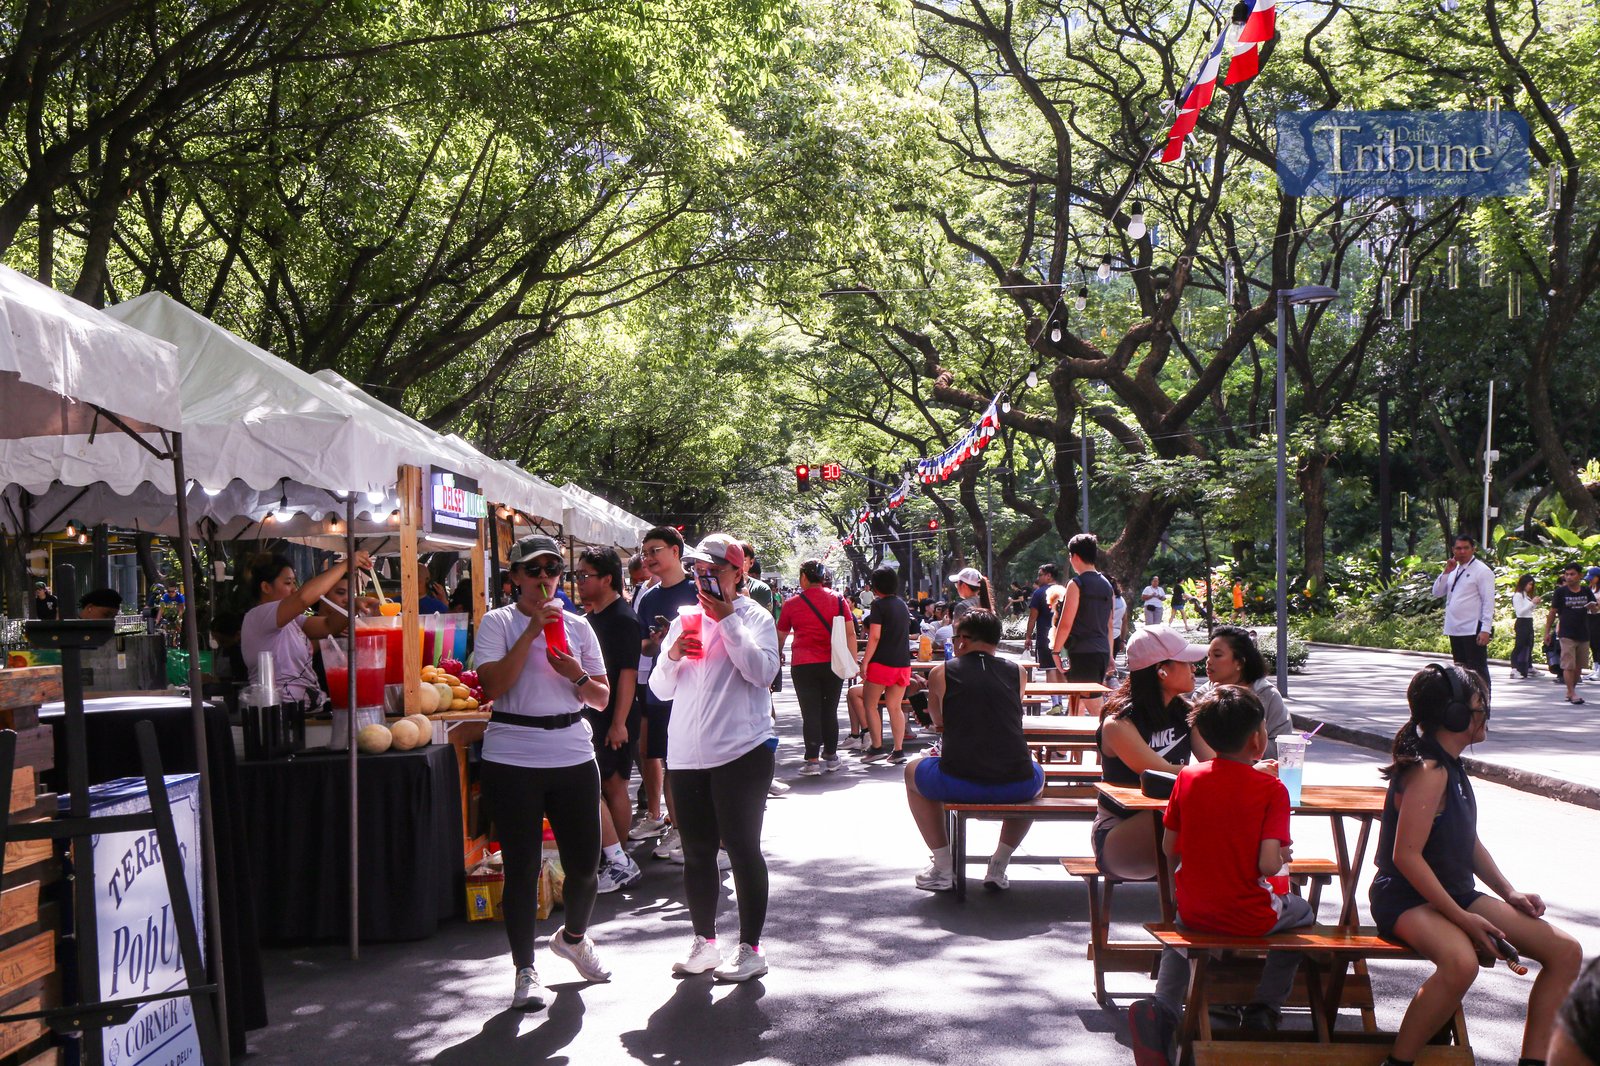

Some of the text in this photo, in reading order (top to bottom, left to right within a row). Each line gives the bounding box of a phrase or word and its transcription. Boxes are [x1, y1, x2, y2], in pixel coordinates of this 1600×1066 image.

[823, 463, 840, 478] 30
[1151, 727, 1175, 748] NIKE
[126, 998, 178, 1057] CORNER
